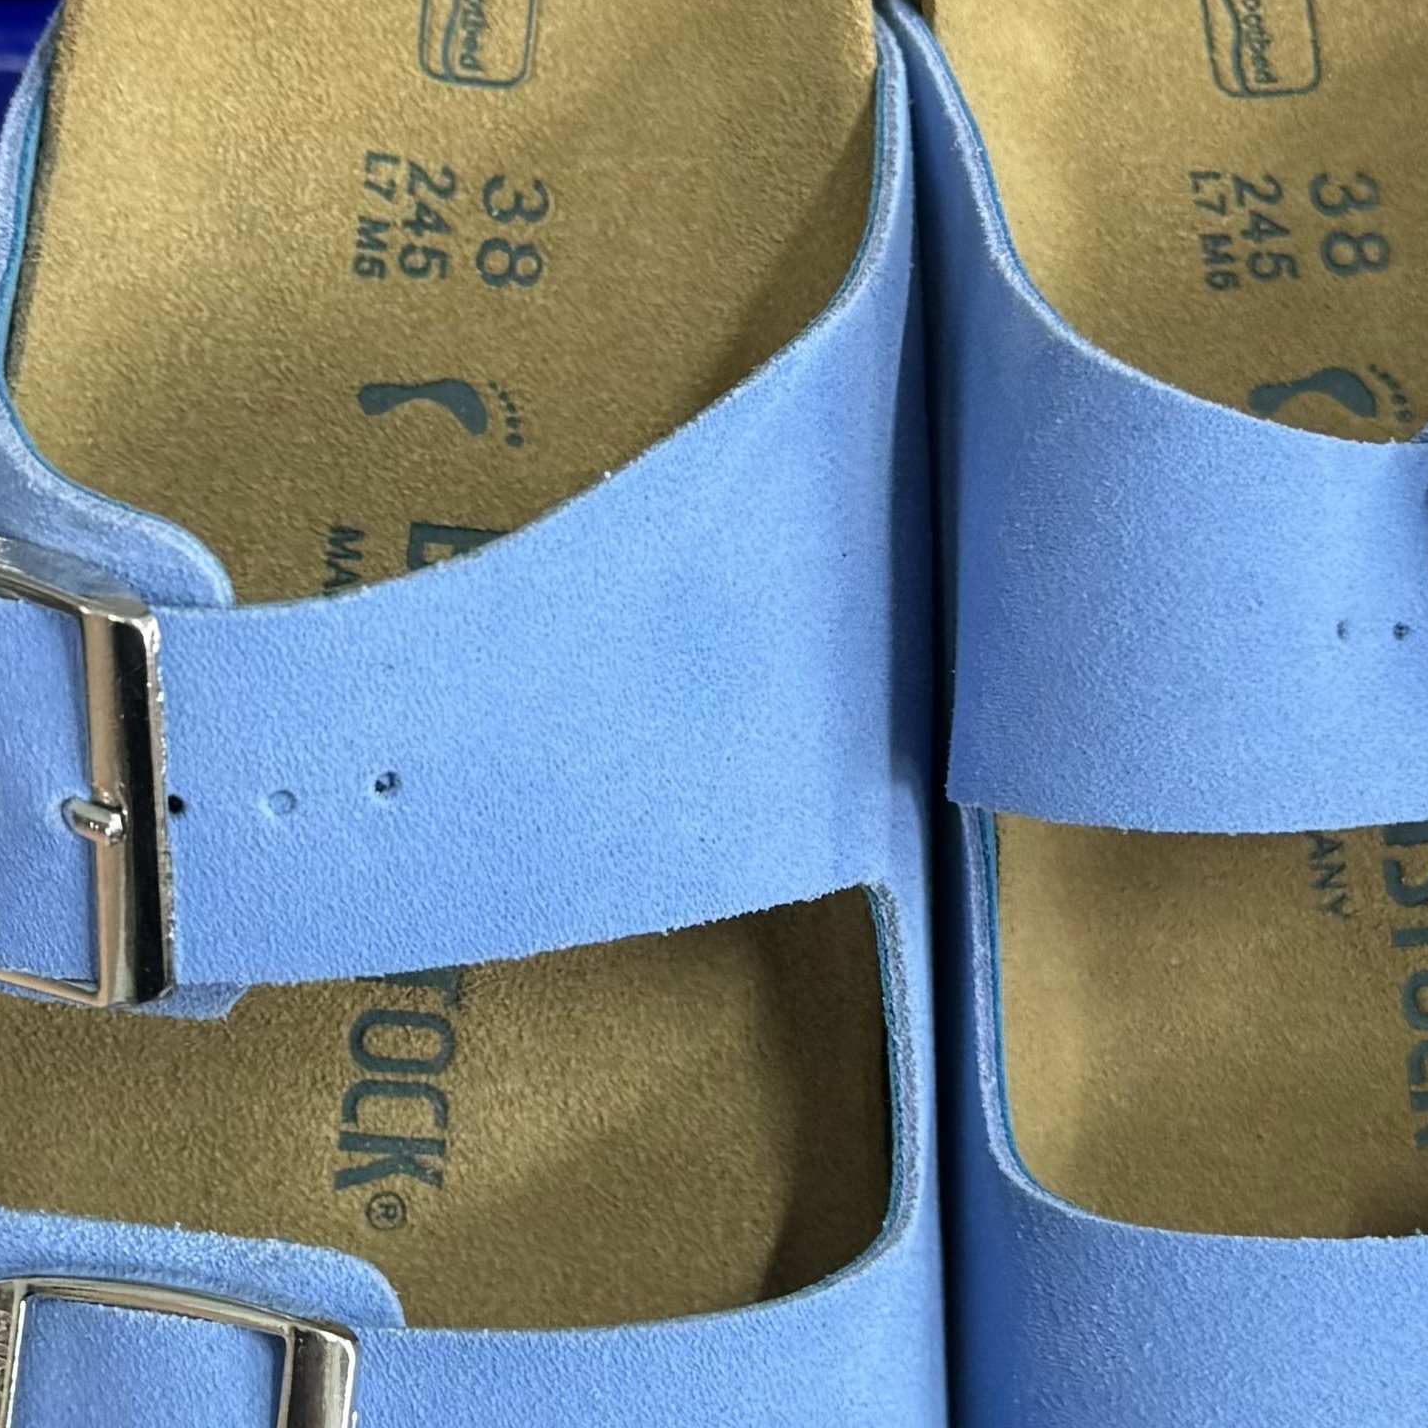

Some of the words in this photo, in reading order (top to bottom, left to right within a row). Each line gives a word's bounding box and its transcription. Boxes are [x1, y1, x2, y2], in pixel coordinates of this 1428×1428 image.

[398, 163, 458, 281] 245
[476, 175, 549, 288] 38
[1233, 175, 1299, 284] 245
[1309, 172, 1390, 278] 38
